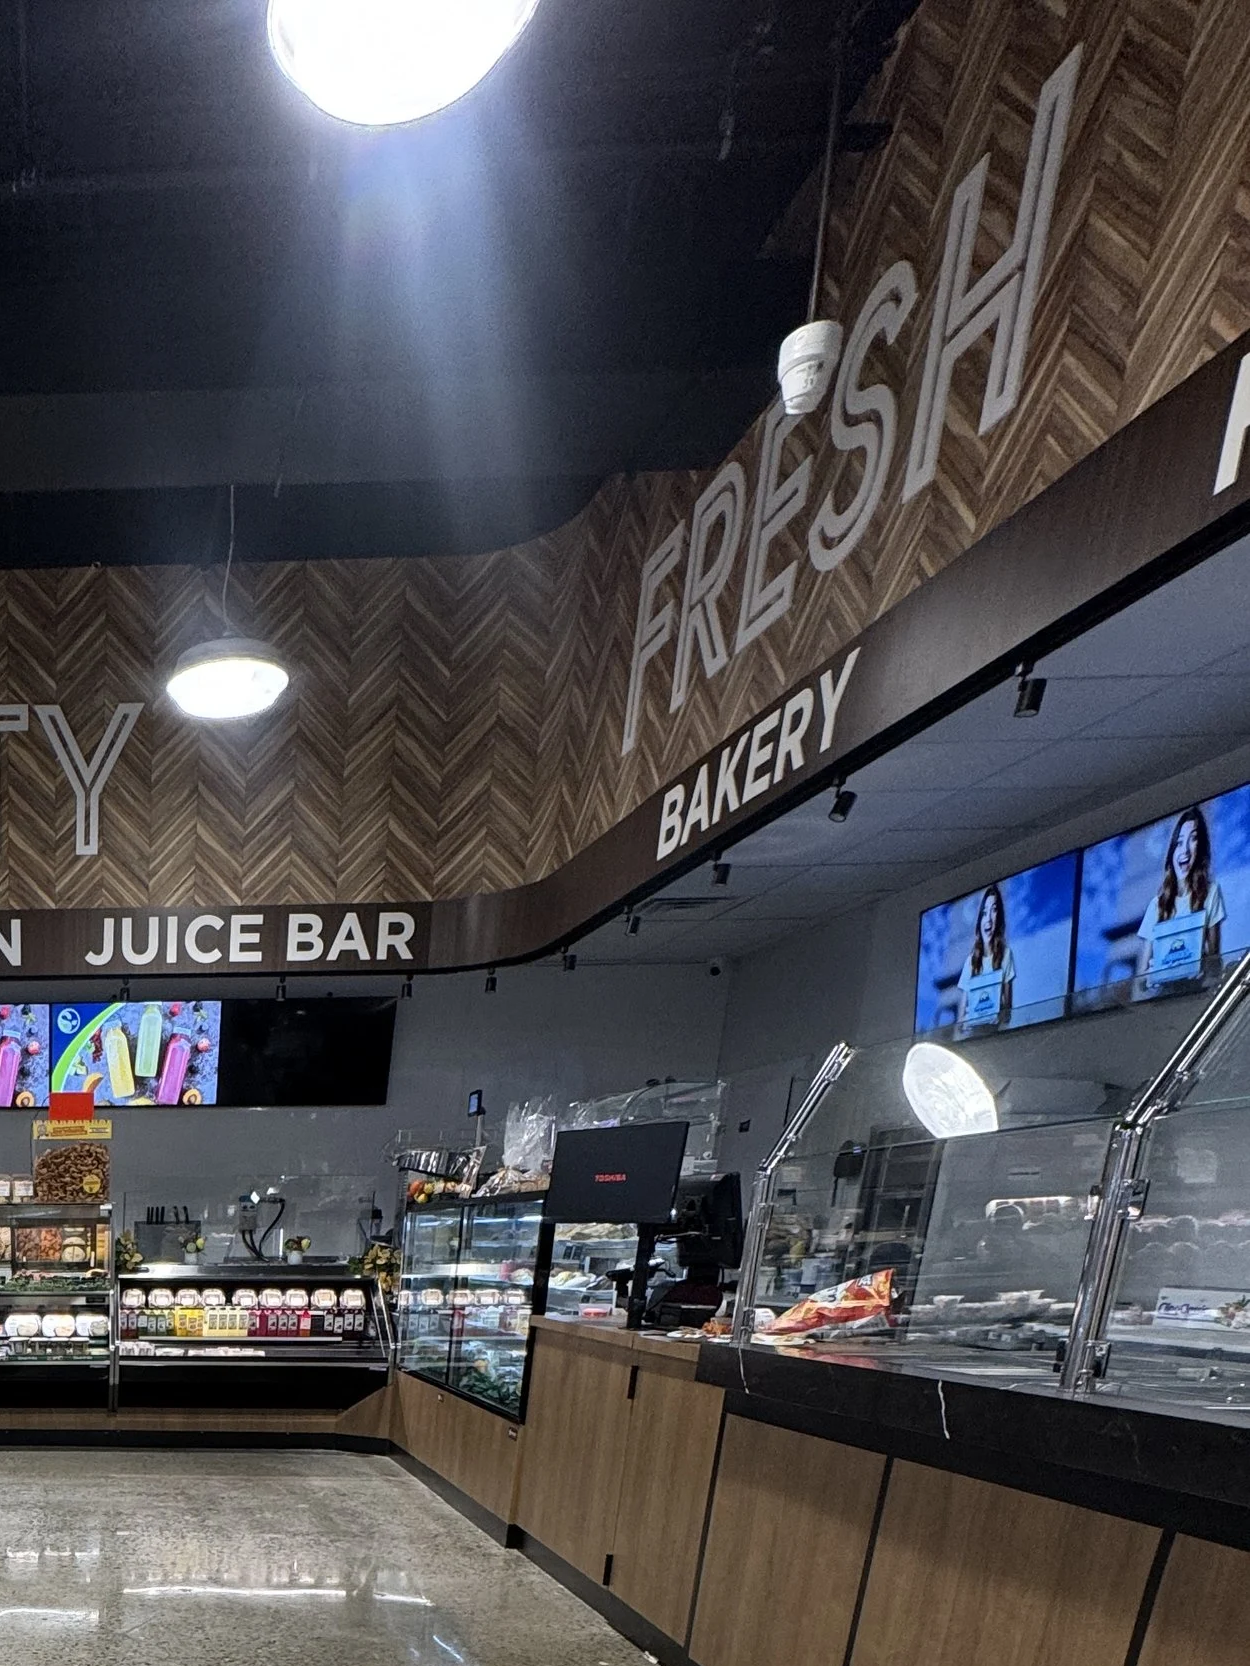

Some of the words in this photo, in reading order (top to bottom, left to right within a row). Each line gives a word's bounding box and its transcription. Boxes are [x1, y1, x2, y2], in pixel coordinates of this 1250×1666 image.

[621, 42, 1084, 756] FRESH
[656, 646, 861, 861] BAKERY
[84, 914, 264, 966] JUICE
[286, 911, 416, 962] BAR
